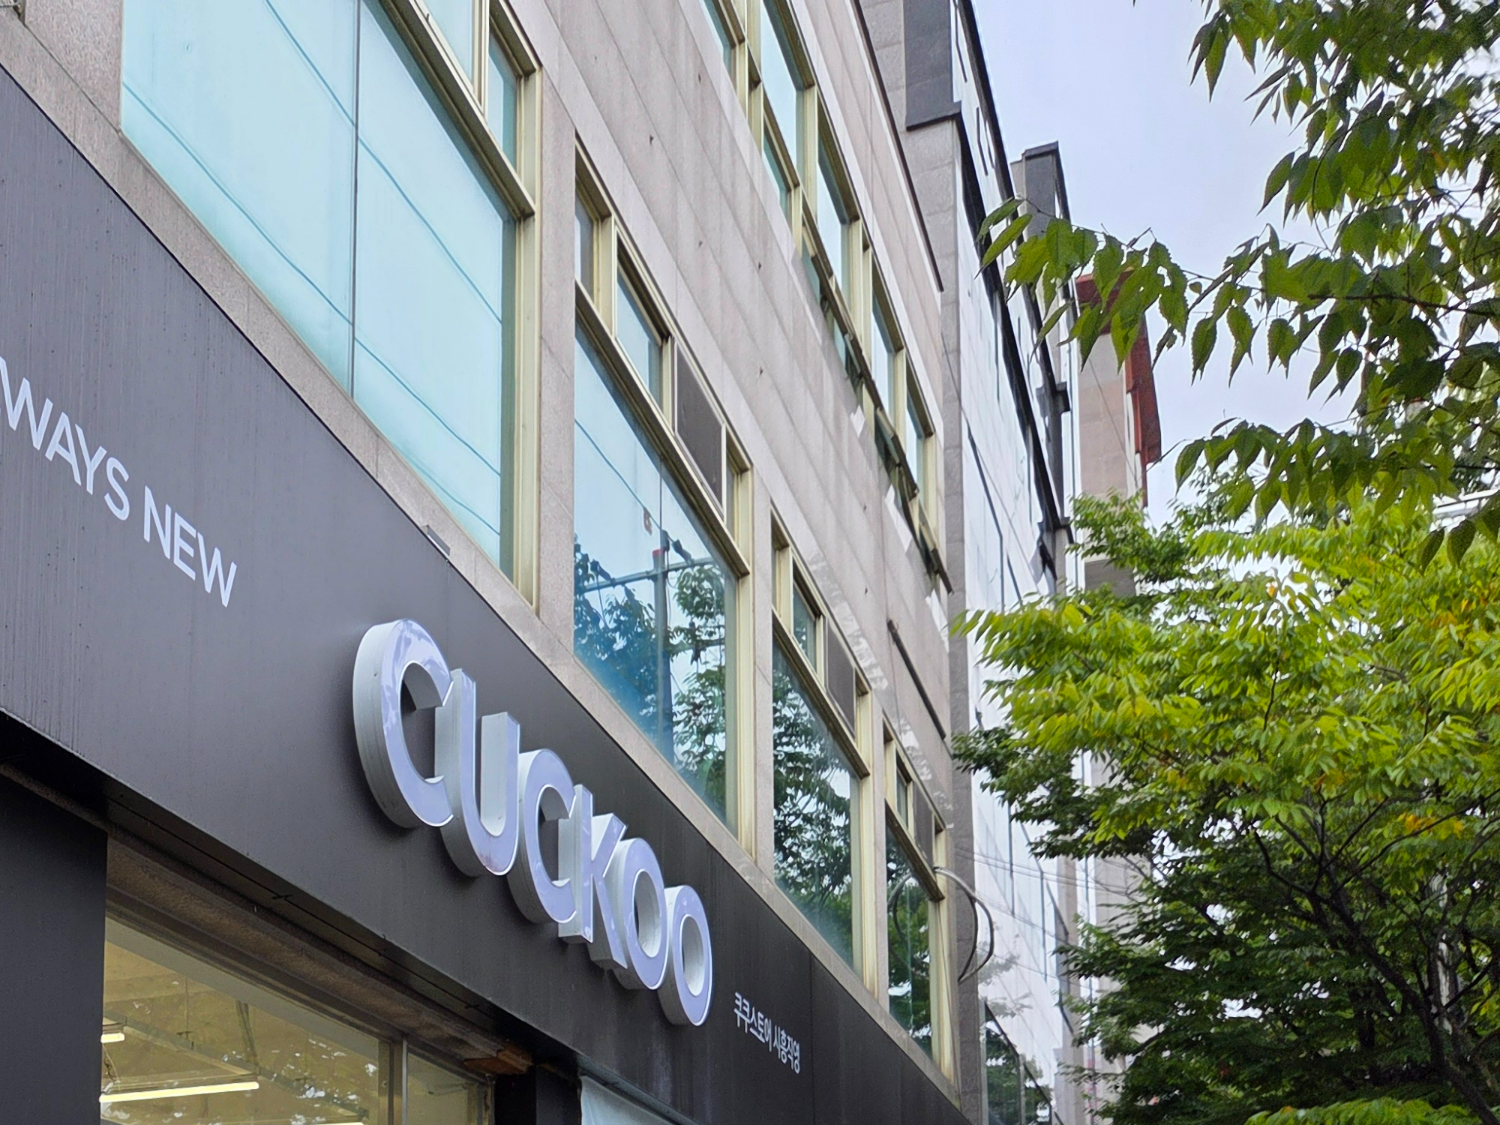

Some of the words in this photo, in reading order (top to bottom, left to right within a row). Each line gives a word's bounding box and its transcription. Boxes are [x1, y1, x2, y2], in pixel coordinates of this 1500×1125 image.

[143, 485, 238, 608] NEW
[353, 617, 712, 1027] CUCKOO
[734, 991, 772, 1052] 쿠쿠스토어
